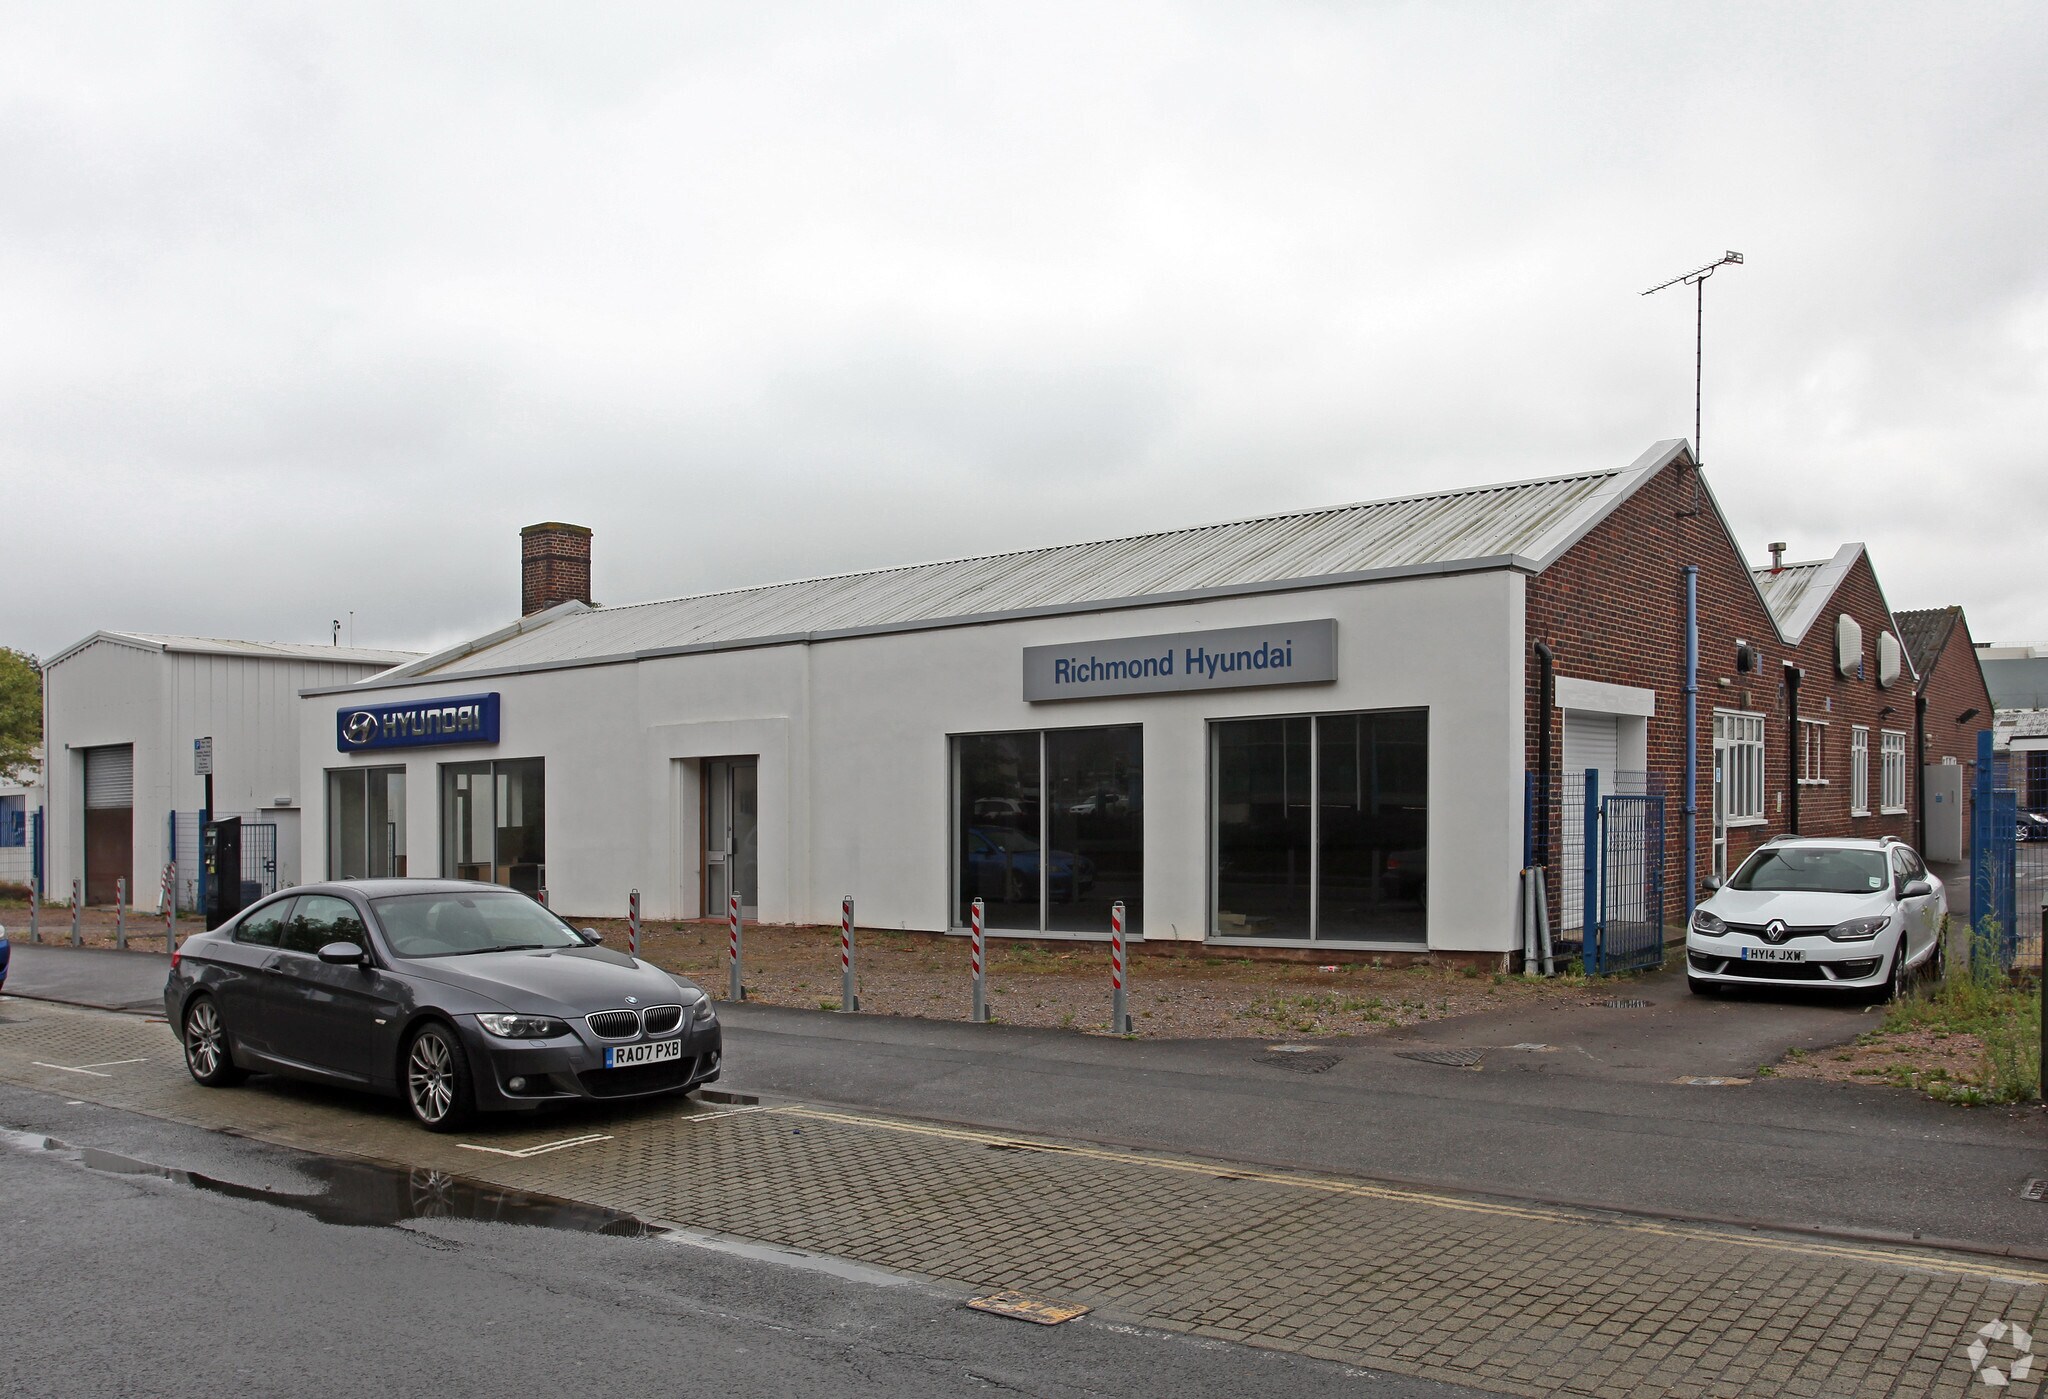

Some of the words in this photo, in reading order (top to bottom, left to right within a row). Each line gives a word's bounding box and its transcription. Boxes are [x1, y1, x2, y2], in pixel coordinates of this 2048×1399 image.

[1055, 649, 1173, 684] Richmond
[1185, 640, 1292, 679] Hyundai
[383, 705, 480, 738] HYUNDAI
[1750, 949, 1776, 960] HY14
[1779, 951, 1801, 961] JXW
[616, 1045, 653, 1064] RA07
[656, 1041, 679, 1059] PXB
